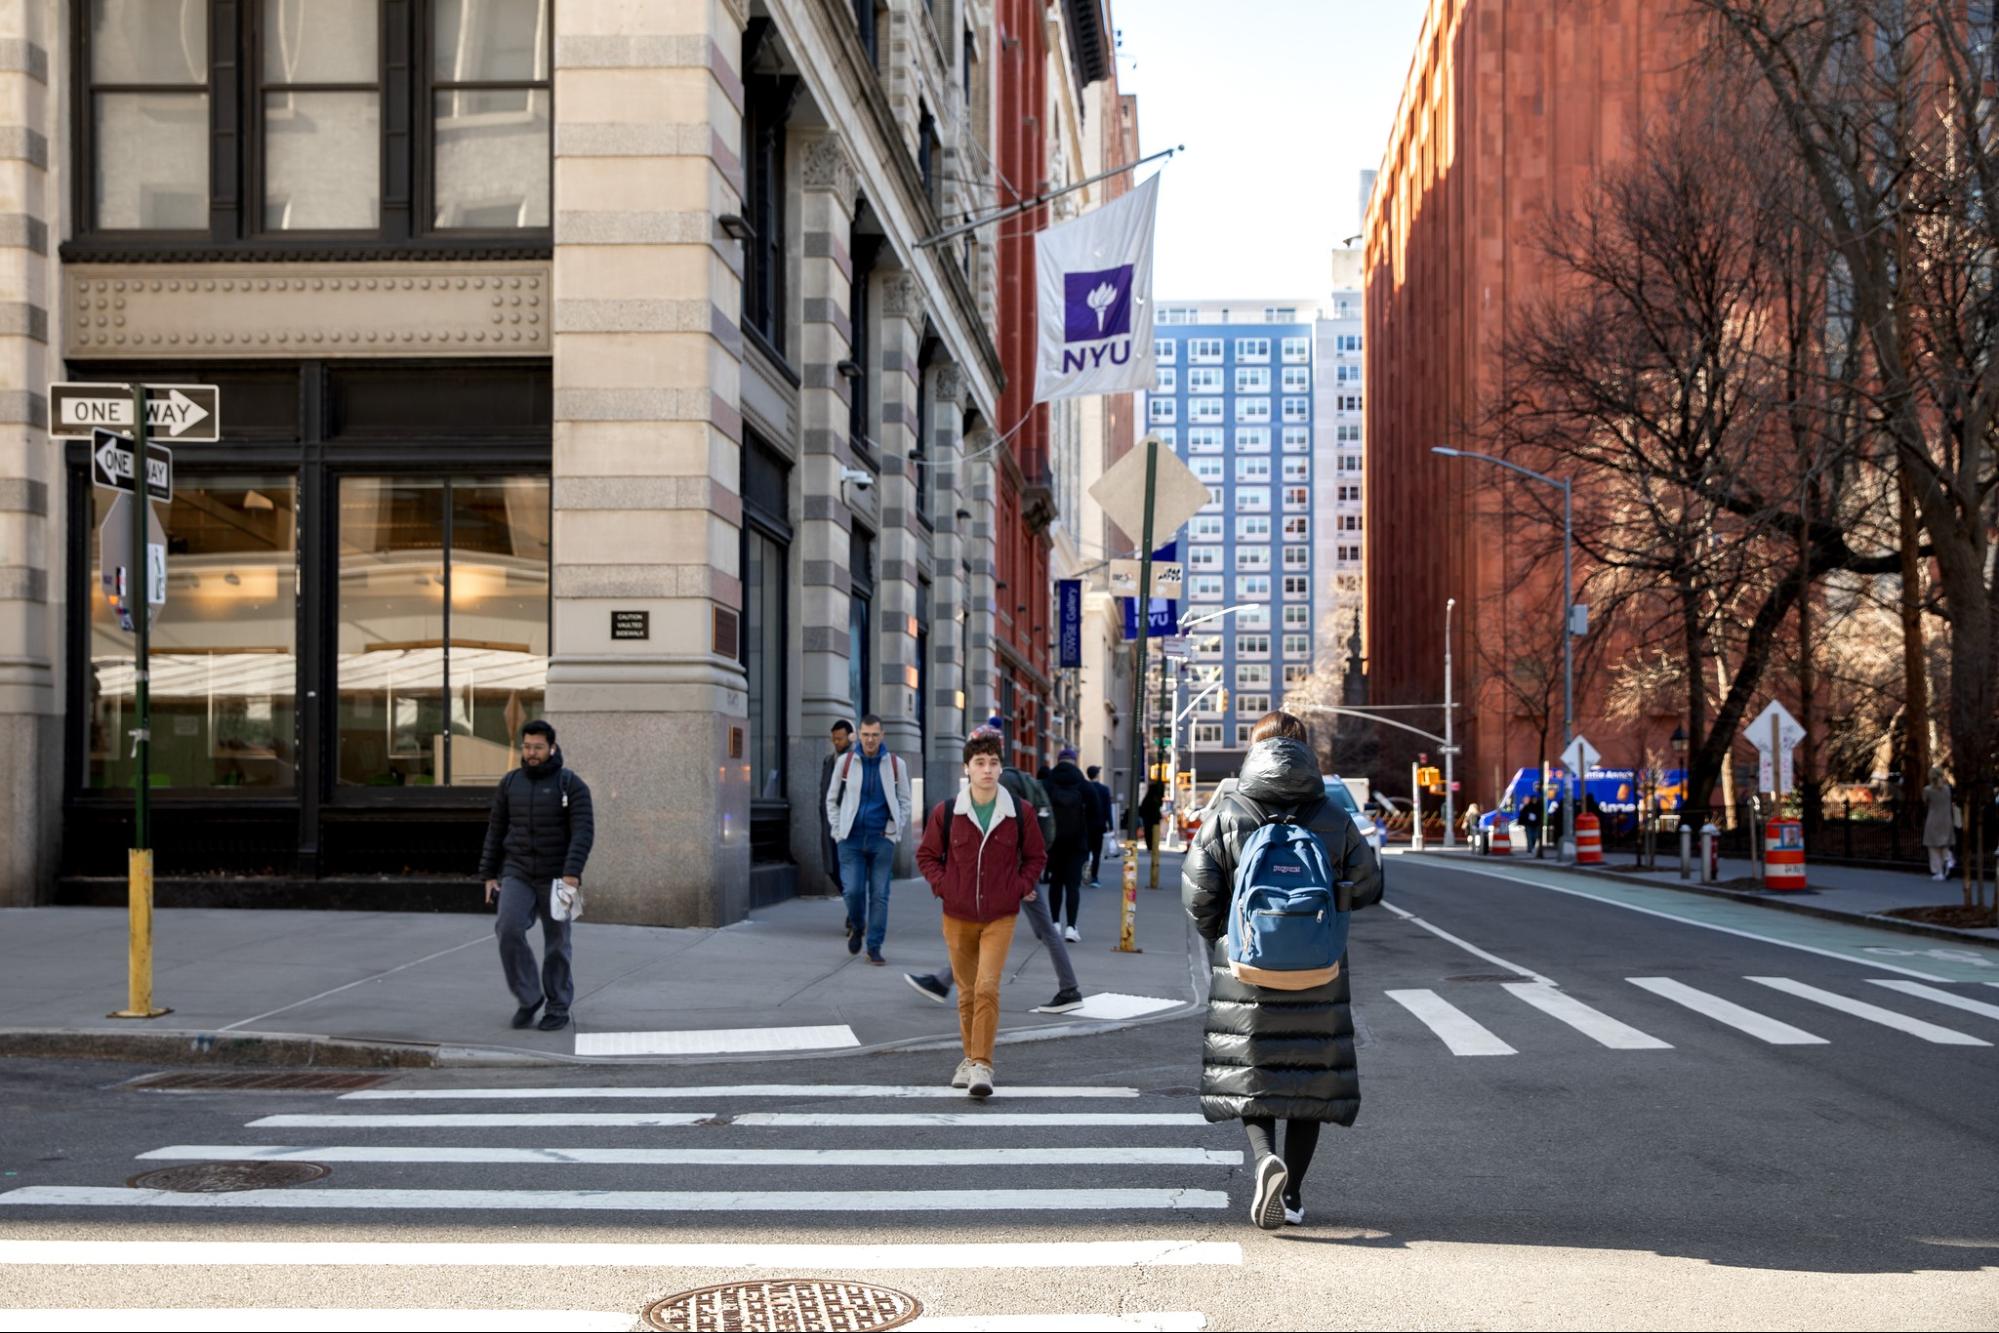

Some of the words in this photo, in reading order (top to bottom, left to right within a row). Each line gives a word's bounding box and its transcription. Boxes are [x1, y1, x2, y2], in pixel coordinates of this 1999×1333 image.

[1062, 340, 1131, 374] NYU
[75, 402, 121, 422] ONE
[146, 403, 191, 423] WAY
[105, 449, 130, 474] ONE
[147, 462, 165, 483] AY
[1066, 587, 1078, 622] Gallery
